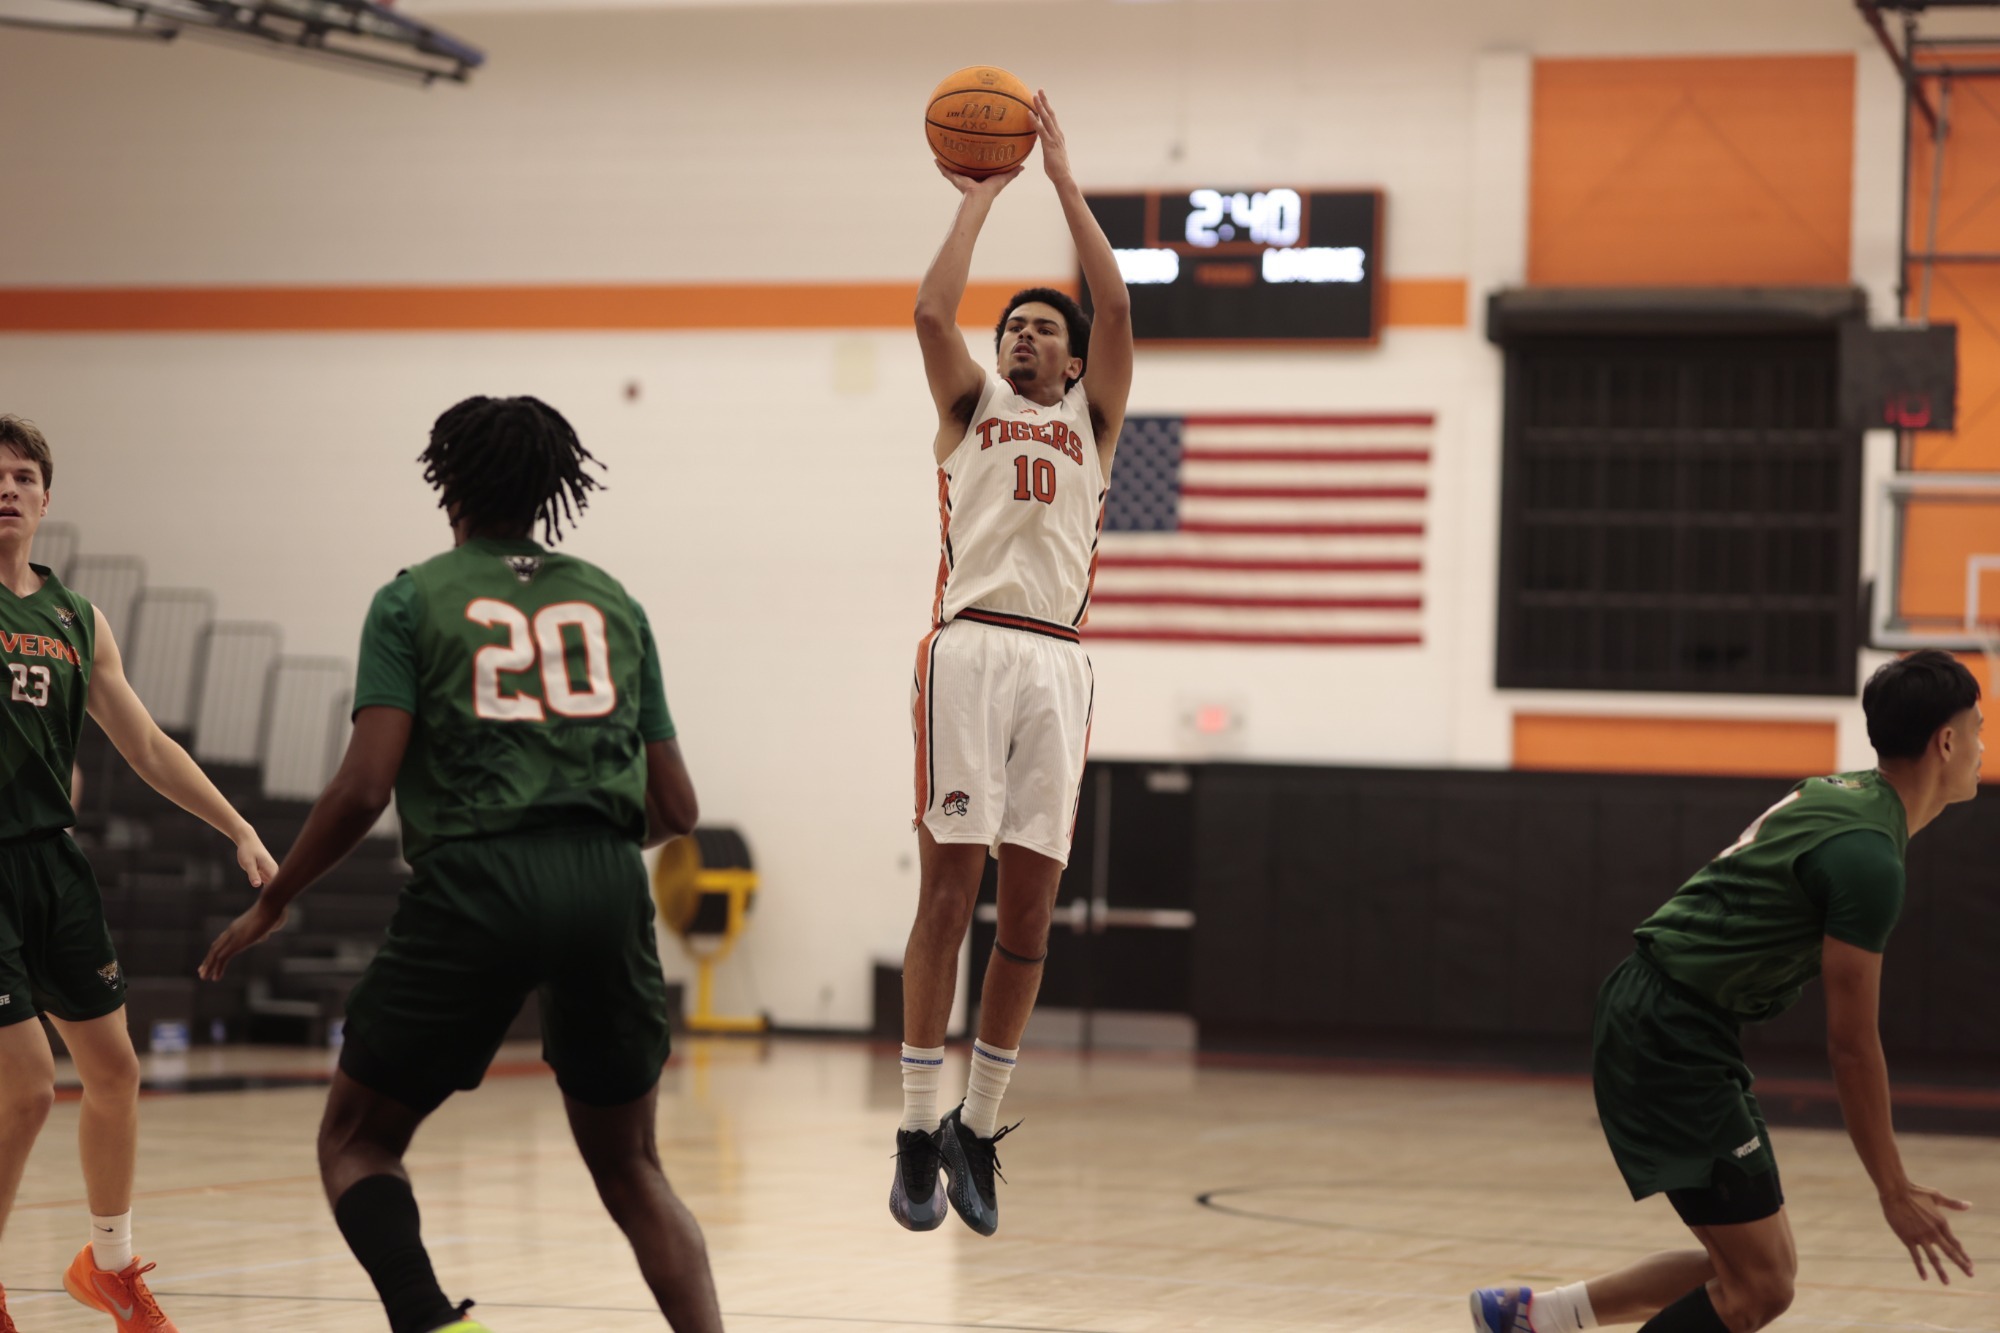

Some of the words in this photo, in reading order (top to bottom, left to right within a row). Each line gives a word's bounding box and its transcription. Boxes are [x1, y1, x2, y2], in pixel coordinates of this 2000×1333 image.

[960, 103, 1007, 122] EVO
[961, 121, 988, 130] OXY
[1186, 189, 1301, 248] 2:40
[976, 417, 1083, 465] TIGERS
[1013, 455, 1056, 505] 10
[0, 630, 82, 670] VERN
[464, 596, 616, 721] 20
[8, 662, 50, 707] 23
